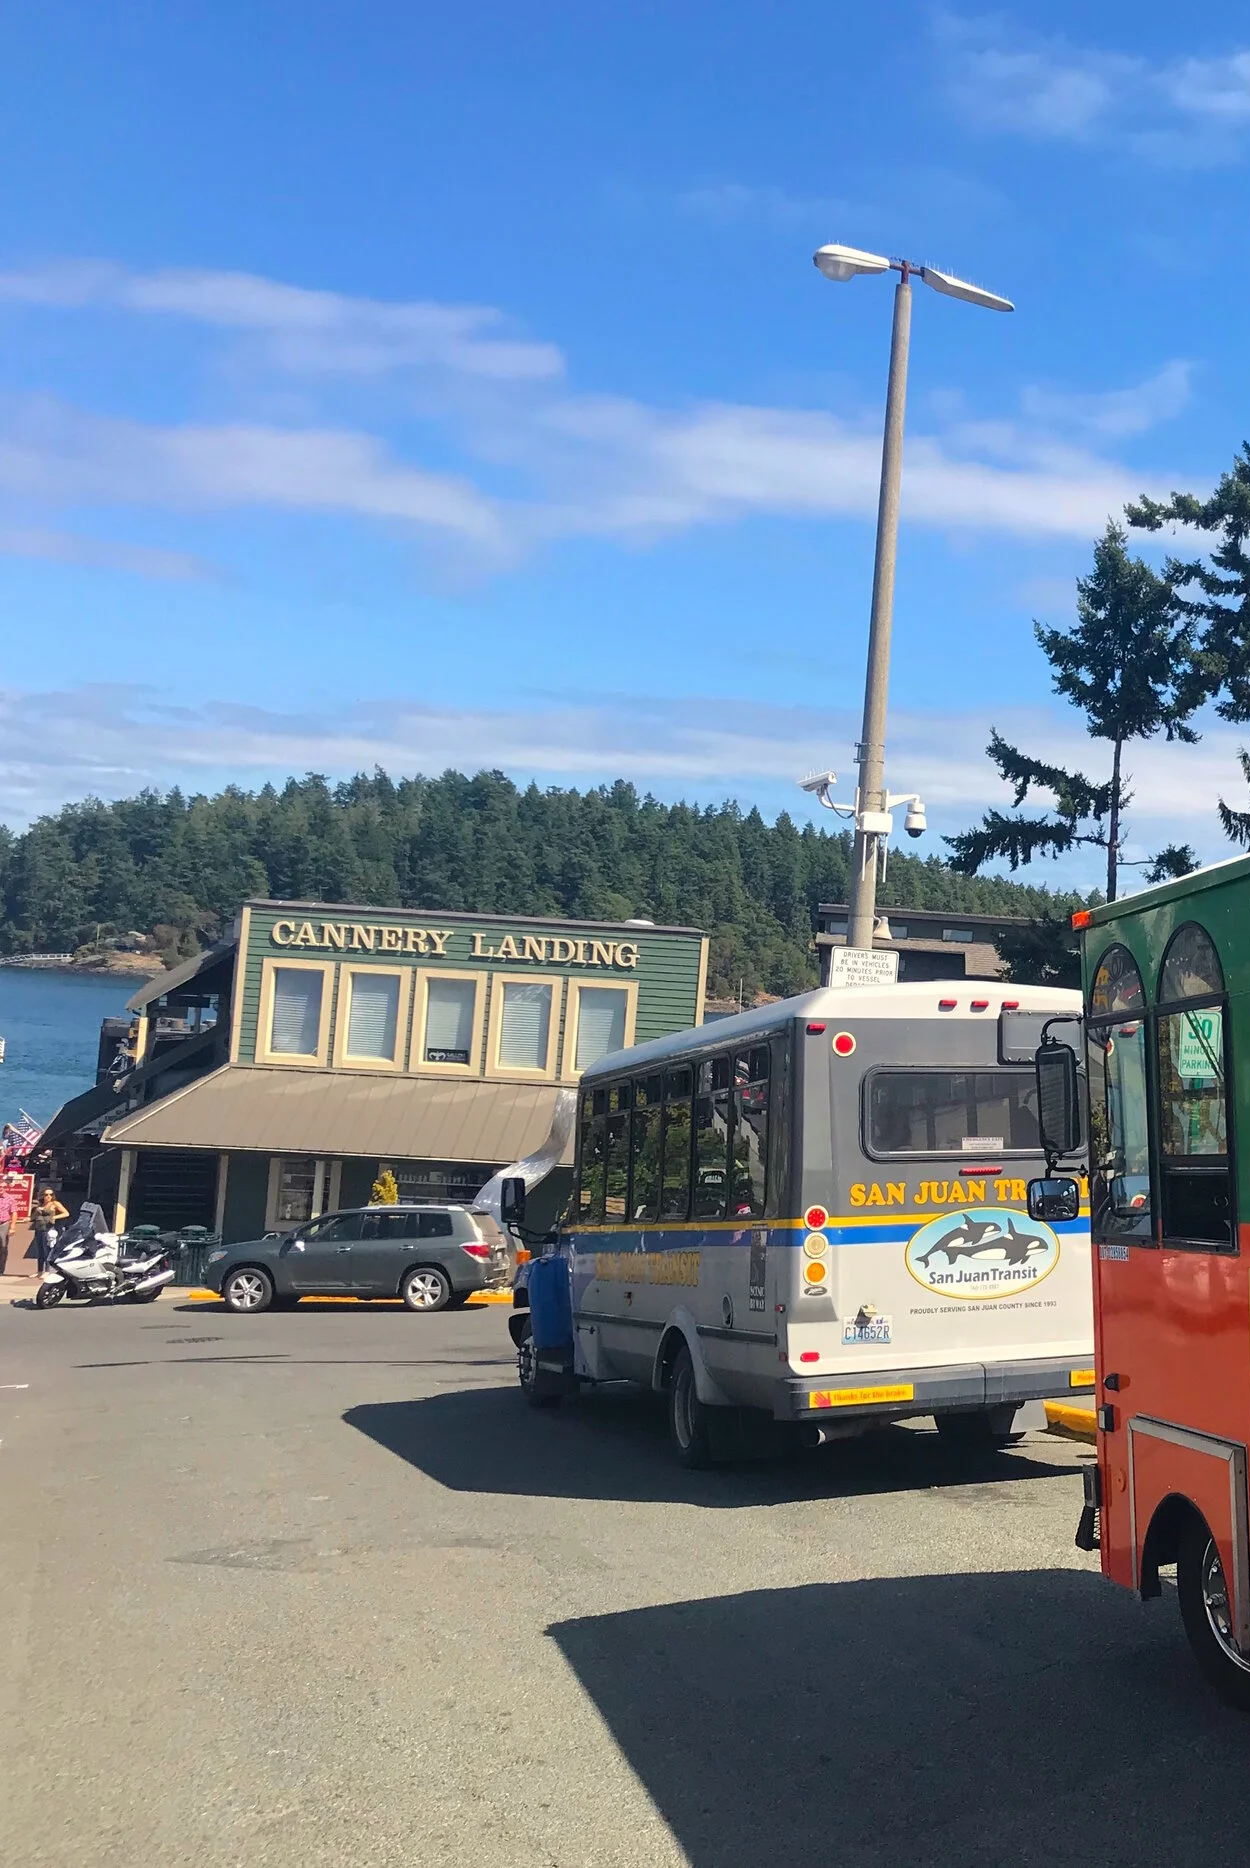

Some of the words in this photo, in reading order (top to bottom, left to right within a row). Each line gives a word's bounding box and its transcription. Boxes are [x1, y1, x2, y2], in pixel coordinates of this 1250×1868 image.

[272, 921, 453, 955] CANNERY
[471, 933, 640, 967] LANDING
[859, 975, 880, 983] VESSEL
[1188, 1018, 1213, 1040] 30
[1181, 1059, 1212, 1070] PARKIN
[849, 1181, 906, 1207] SAN
[914, 1179, 987, 1205] JUAN
[648, 1251, 701, 1287] TRANSIT
[929, 1271, 954, 1285] San
[956, 1270, 989, 1283] Juan
[990, 1266, 1038, 1281] Transit
[910, 1307, 938, 1315] PROUDLY
[845, 1325, 890, 1340] C14652R
[834, 1392, 858, 1401] Thanks
[860, 1391, 870, 1399] for
[872, 1391, 884, 1399] the
